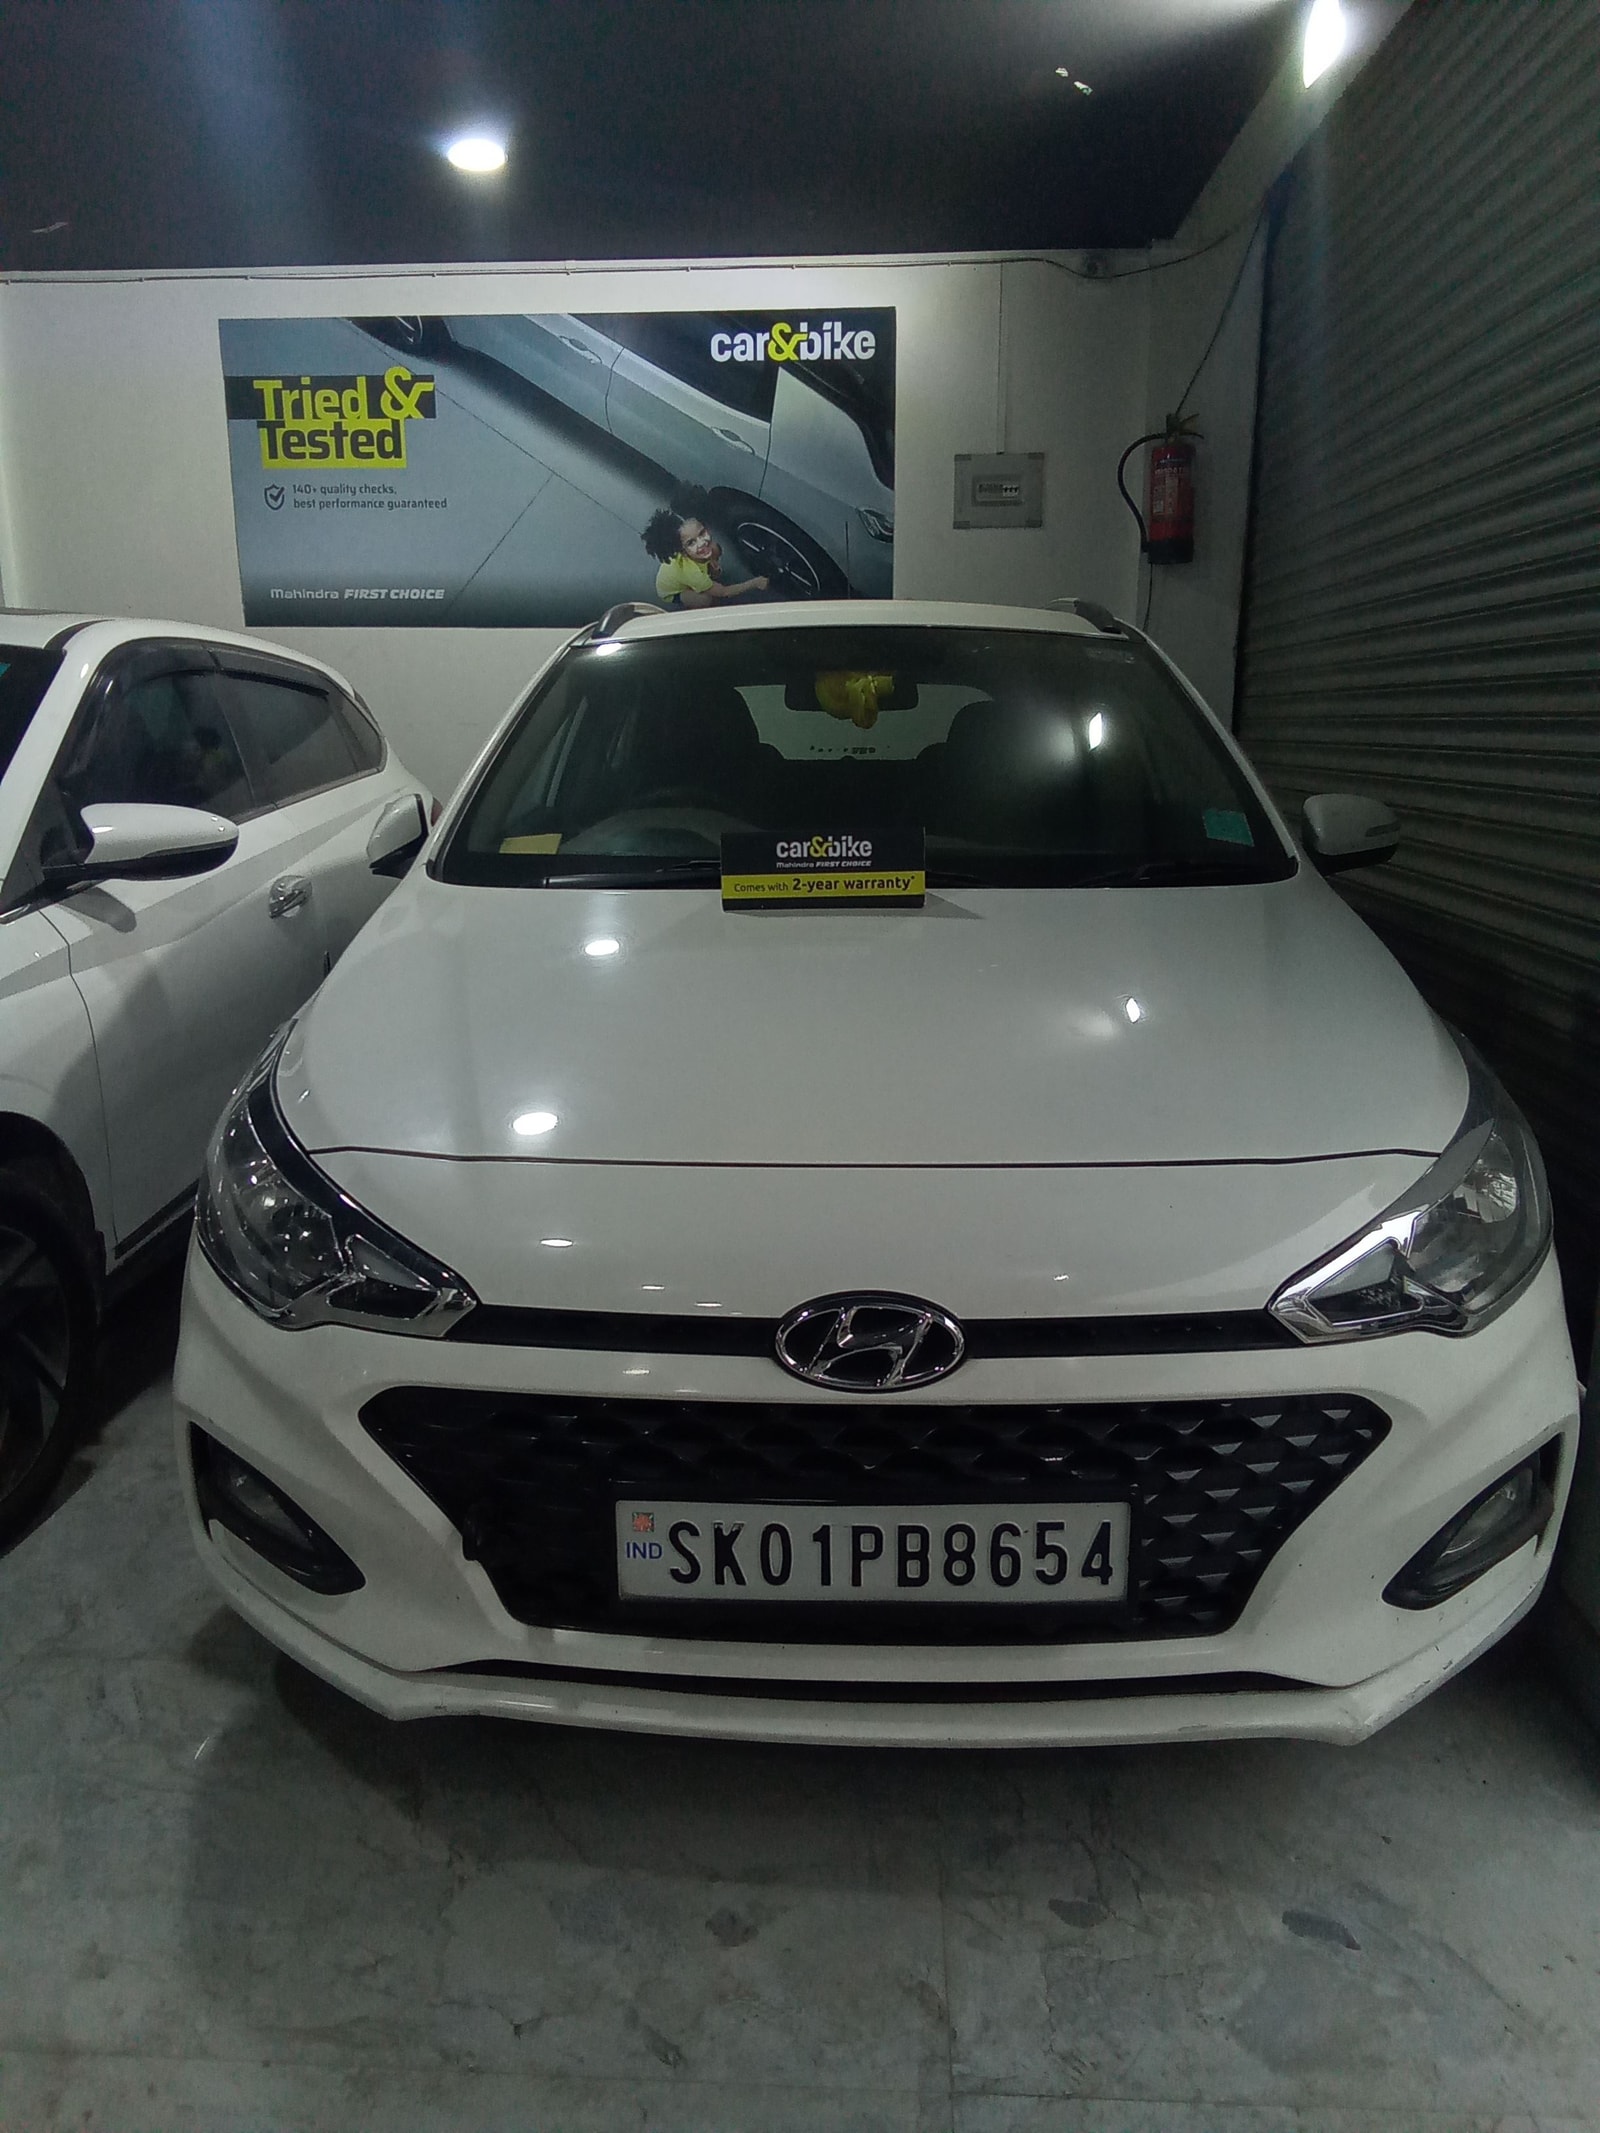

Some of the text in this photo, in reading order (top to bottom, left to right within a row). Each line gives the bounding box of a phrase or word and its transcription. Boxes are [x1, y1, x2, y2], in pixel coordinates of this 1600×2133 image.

[711, 321, 876, 362] car&bike
[253, 366, 435, 420] Tried &
[257, 419, 402, 460] Tested
[292, 483, 397, 497] 140+ quality checks,
[293, 498, 448, 511] best performance guaranteed
[270, 588, 445, 599] Mahindra FIRST CHOICE
[776, 835, 873, 858] car&bike
[776, 861, 815, 869] Mahindra
[815, 860, 840, 868] FIRST
[734, 882, 766, 893] Comes
[767, 881, 789, 892] with
[792, 877, 840, 893] 2-year
[626, 1519, 1115, 1588] IND SK01PB8654
